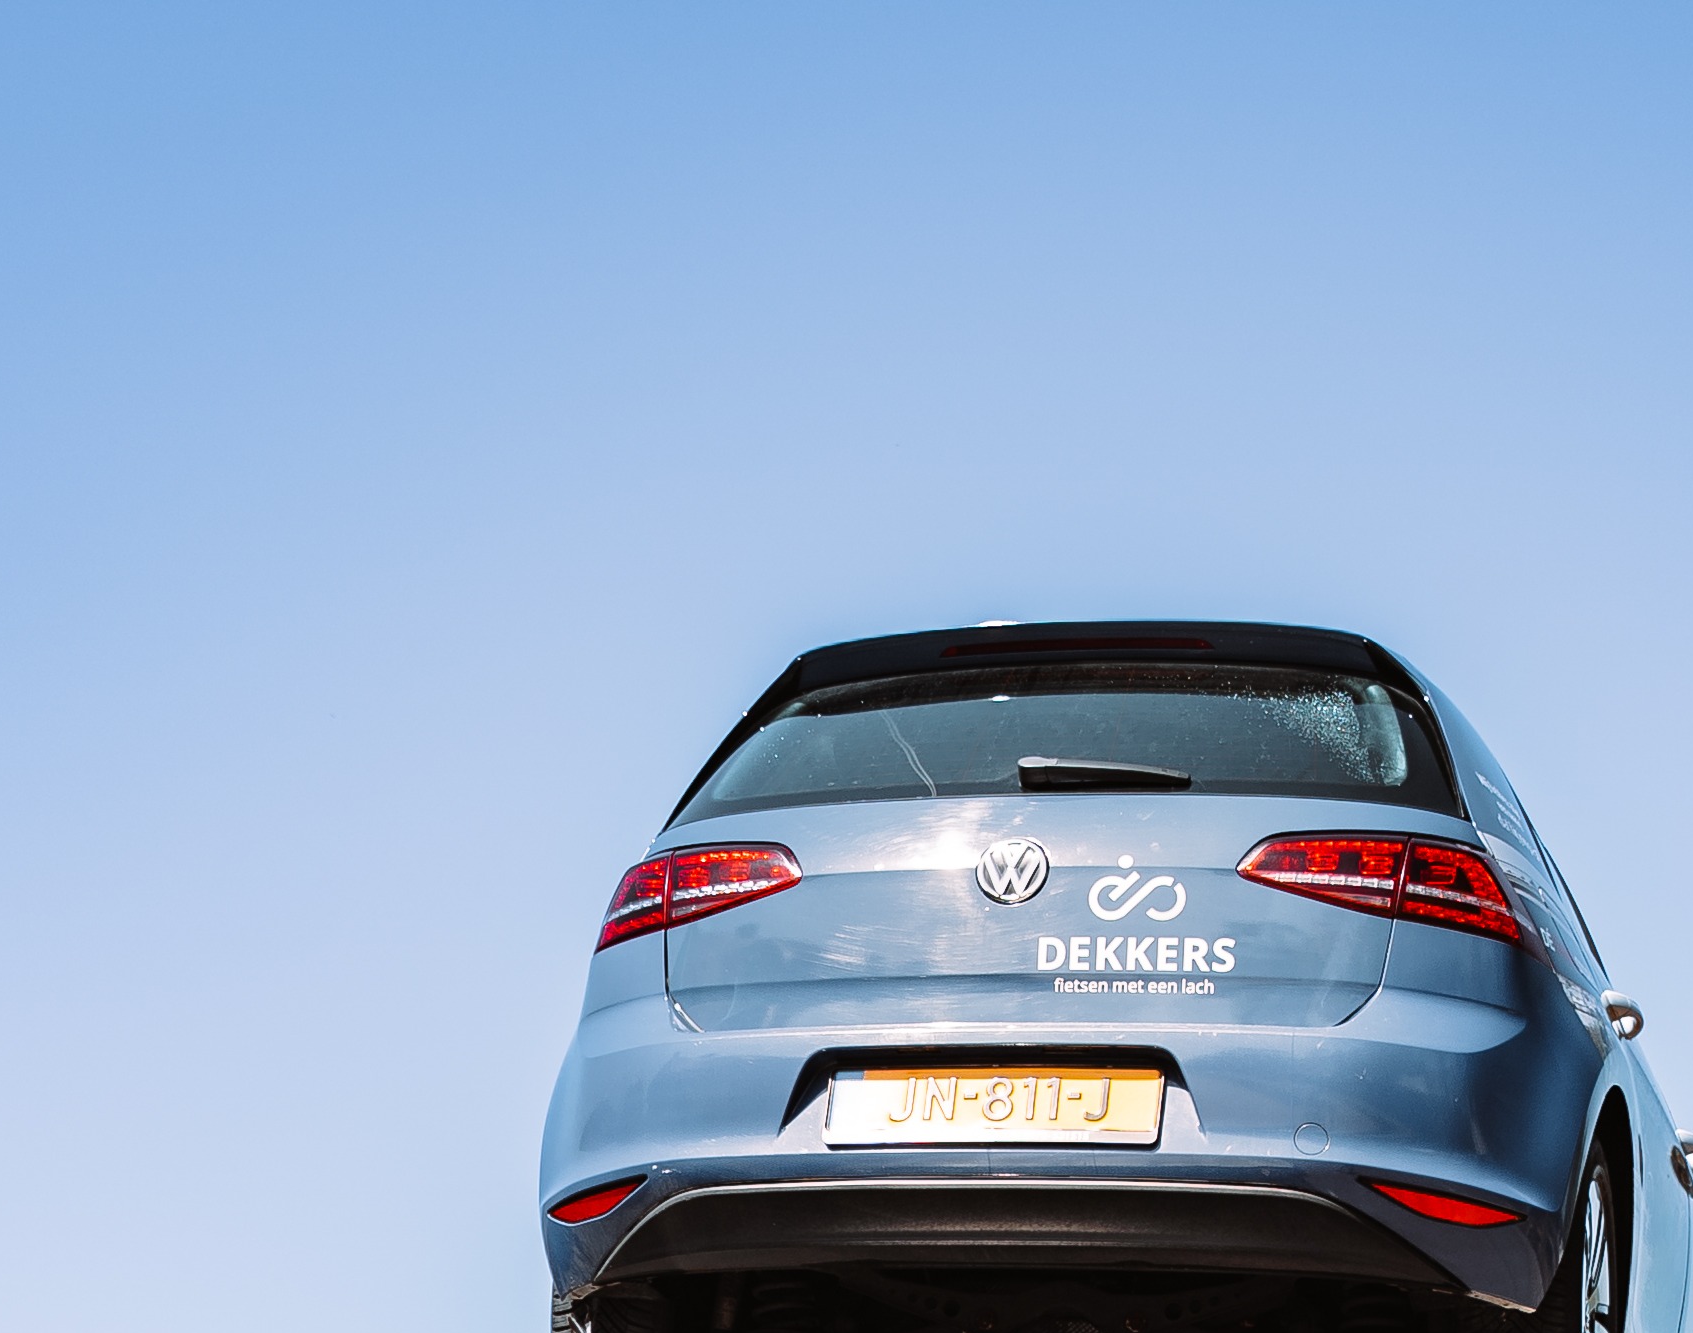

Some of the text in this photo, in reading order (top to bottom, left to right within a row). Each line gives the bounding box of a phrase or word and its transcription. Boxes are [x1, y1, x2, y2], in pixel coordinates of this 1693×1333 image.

[1037, 936, 1236, 973] DEKKERS
[1053, 977, 1215, 995] fietsen met een lach
[889, 1077, 1111, 1122] JN-811-J
